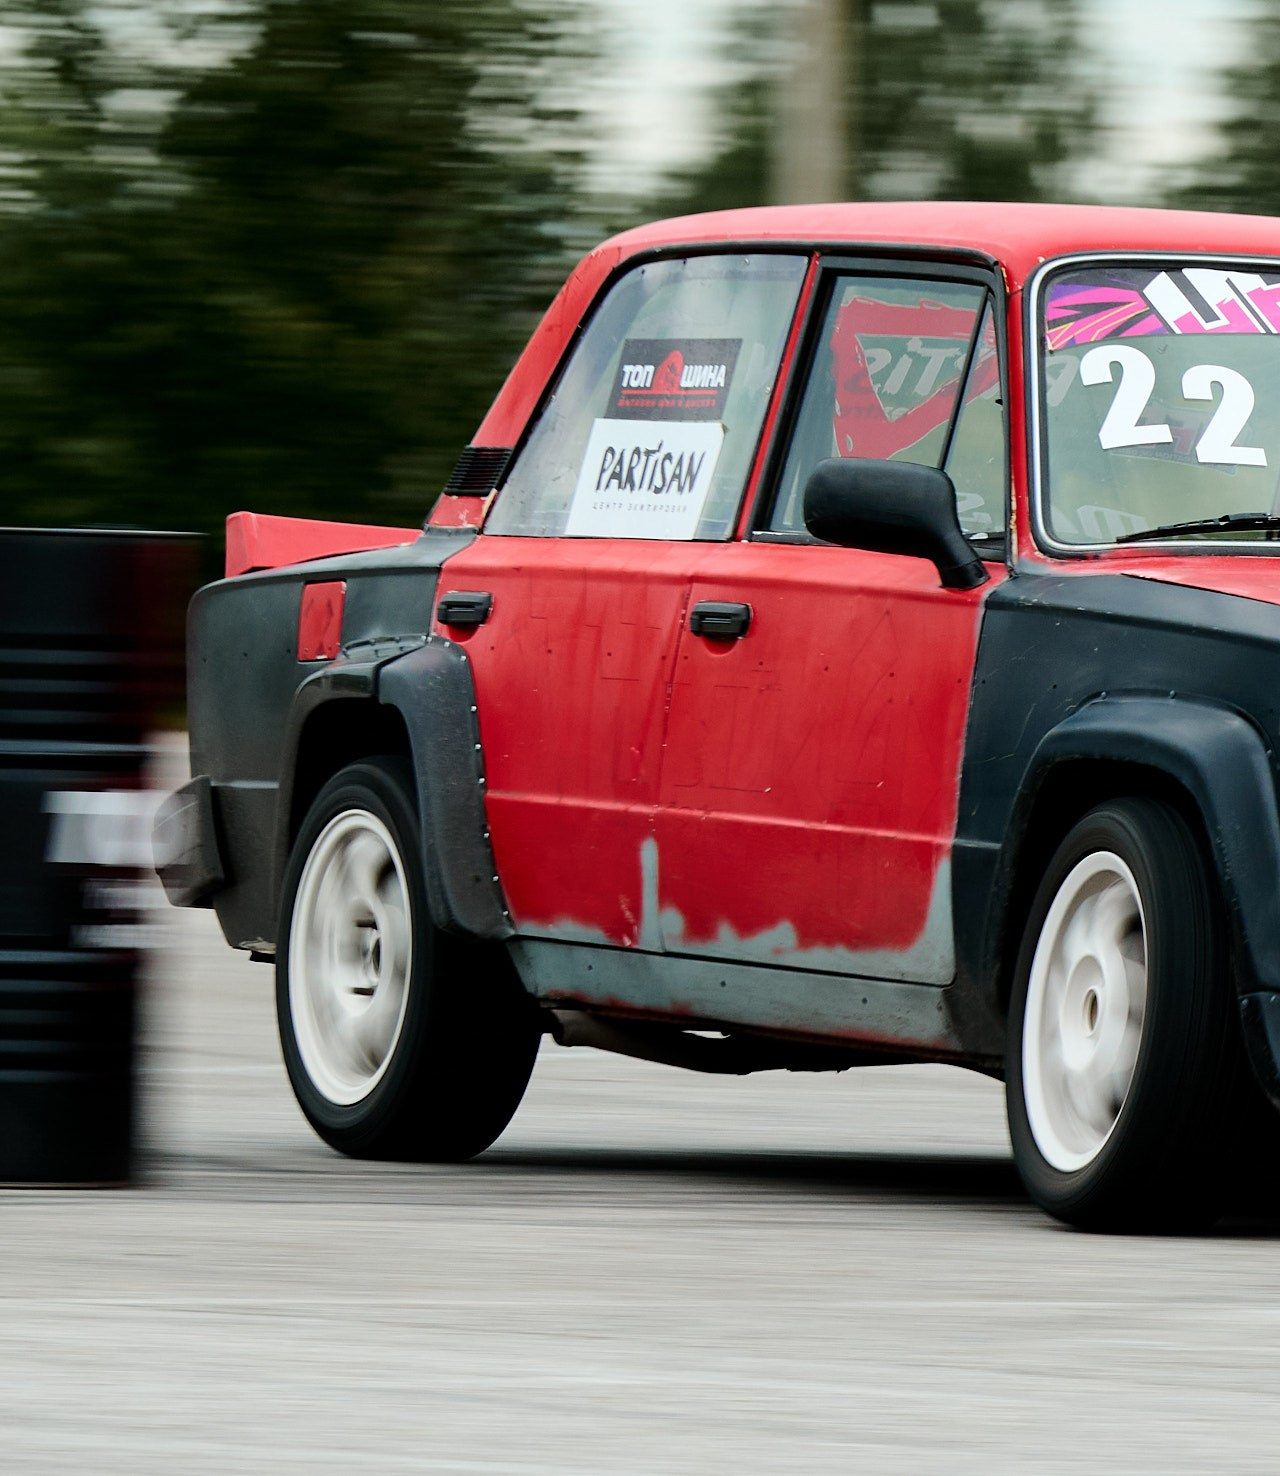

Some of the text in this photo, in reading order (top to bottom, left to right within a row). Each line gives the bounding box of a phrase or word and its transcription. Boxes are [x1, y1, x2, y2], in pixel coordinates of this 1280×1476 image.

[621, 364, 727, 388] ТОП ШИНА
[1079, 344, 1268, 467] 22
